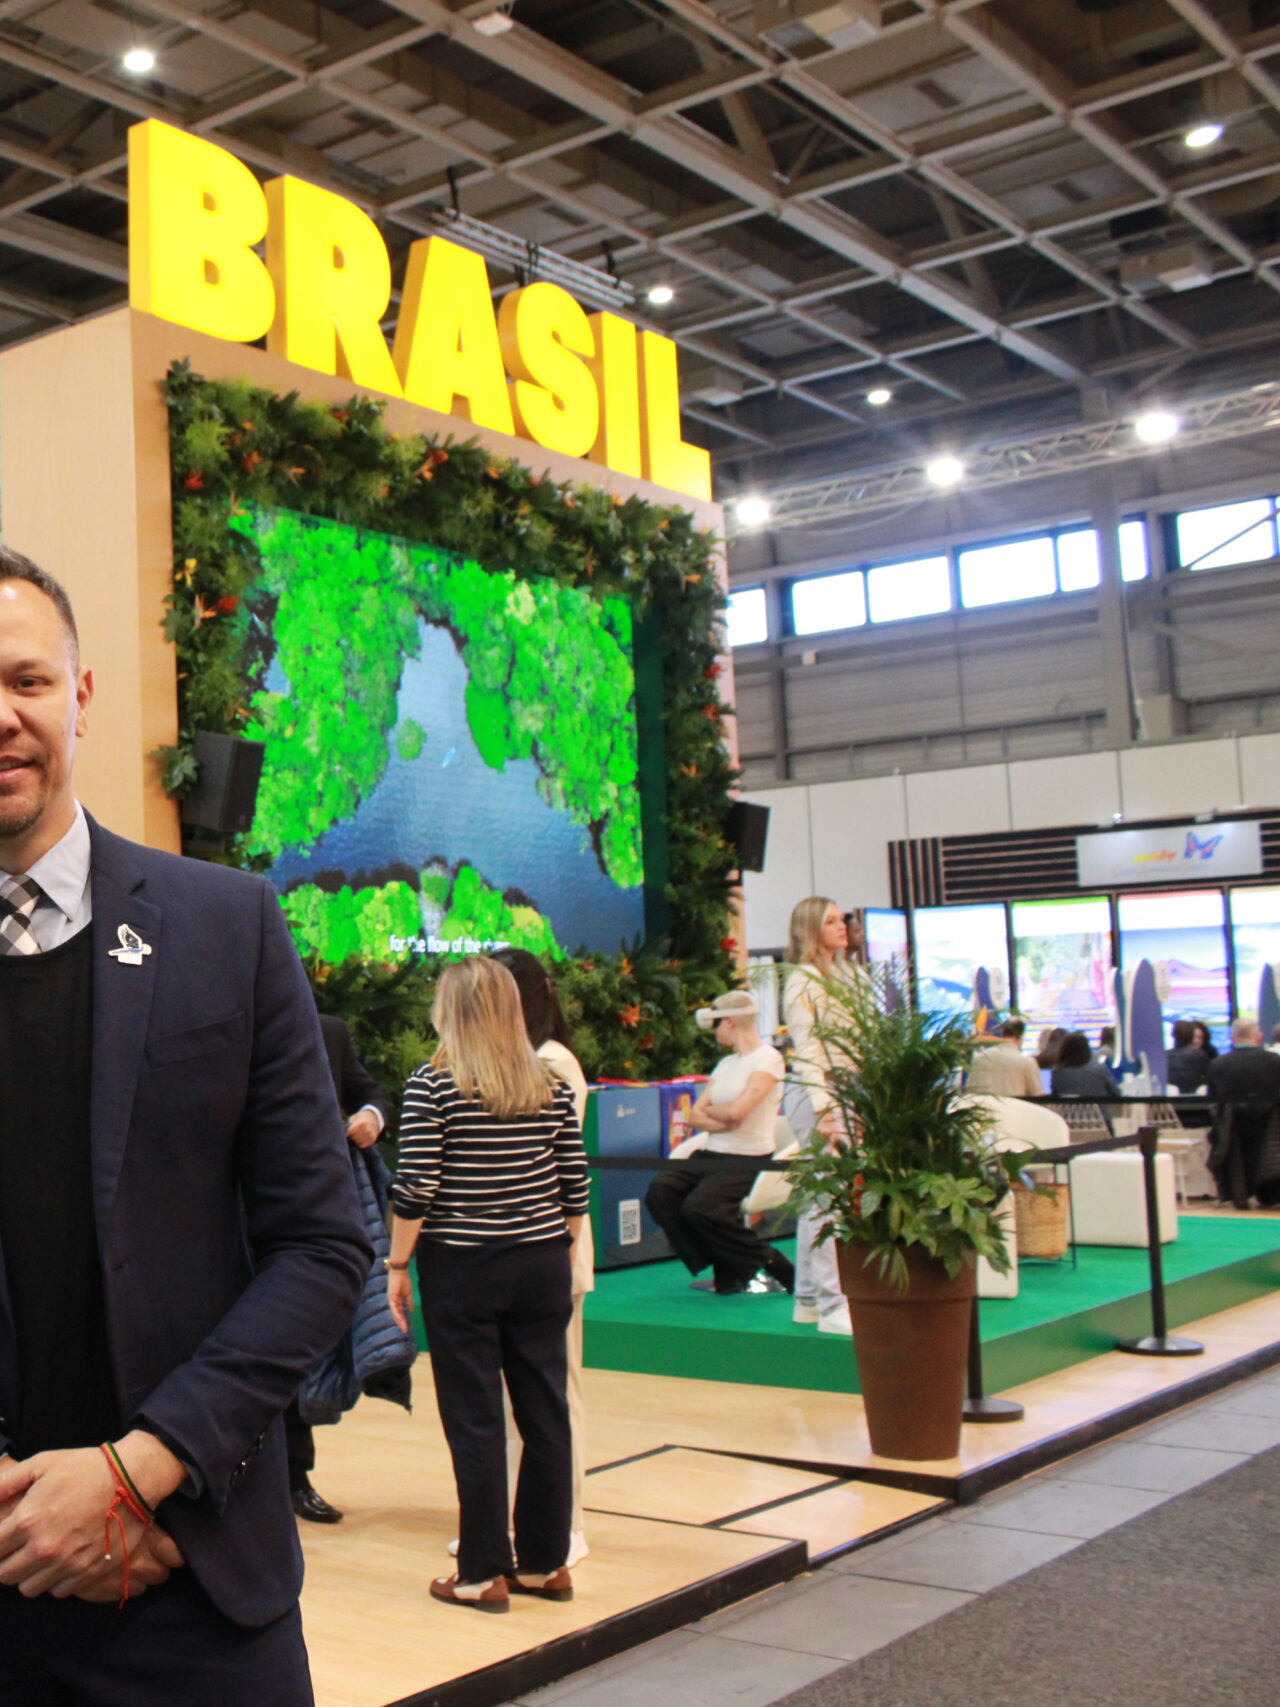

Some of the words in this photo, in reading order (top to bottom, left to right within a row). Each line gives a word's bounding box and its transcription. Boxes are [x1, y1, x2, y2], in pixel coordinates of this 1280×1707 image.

[128, 118, 712, 502] BRASIL
[389, 934, 405, 952] for
[427, 935, 449, 952] flow
[451, 936, 464, 953] of
[465, 936, 482, 953] the
